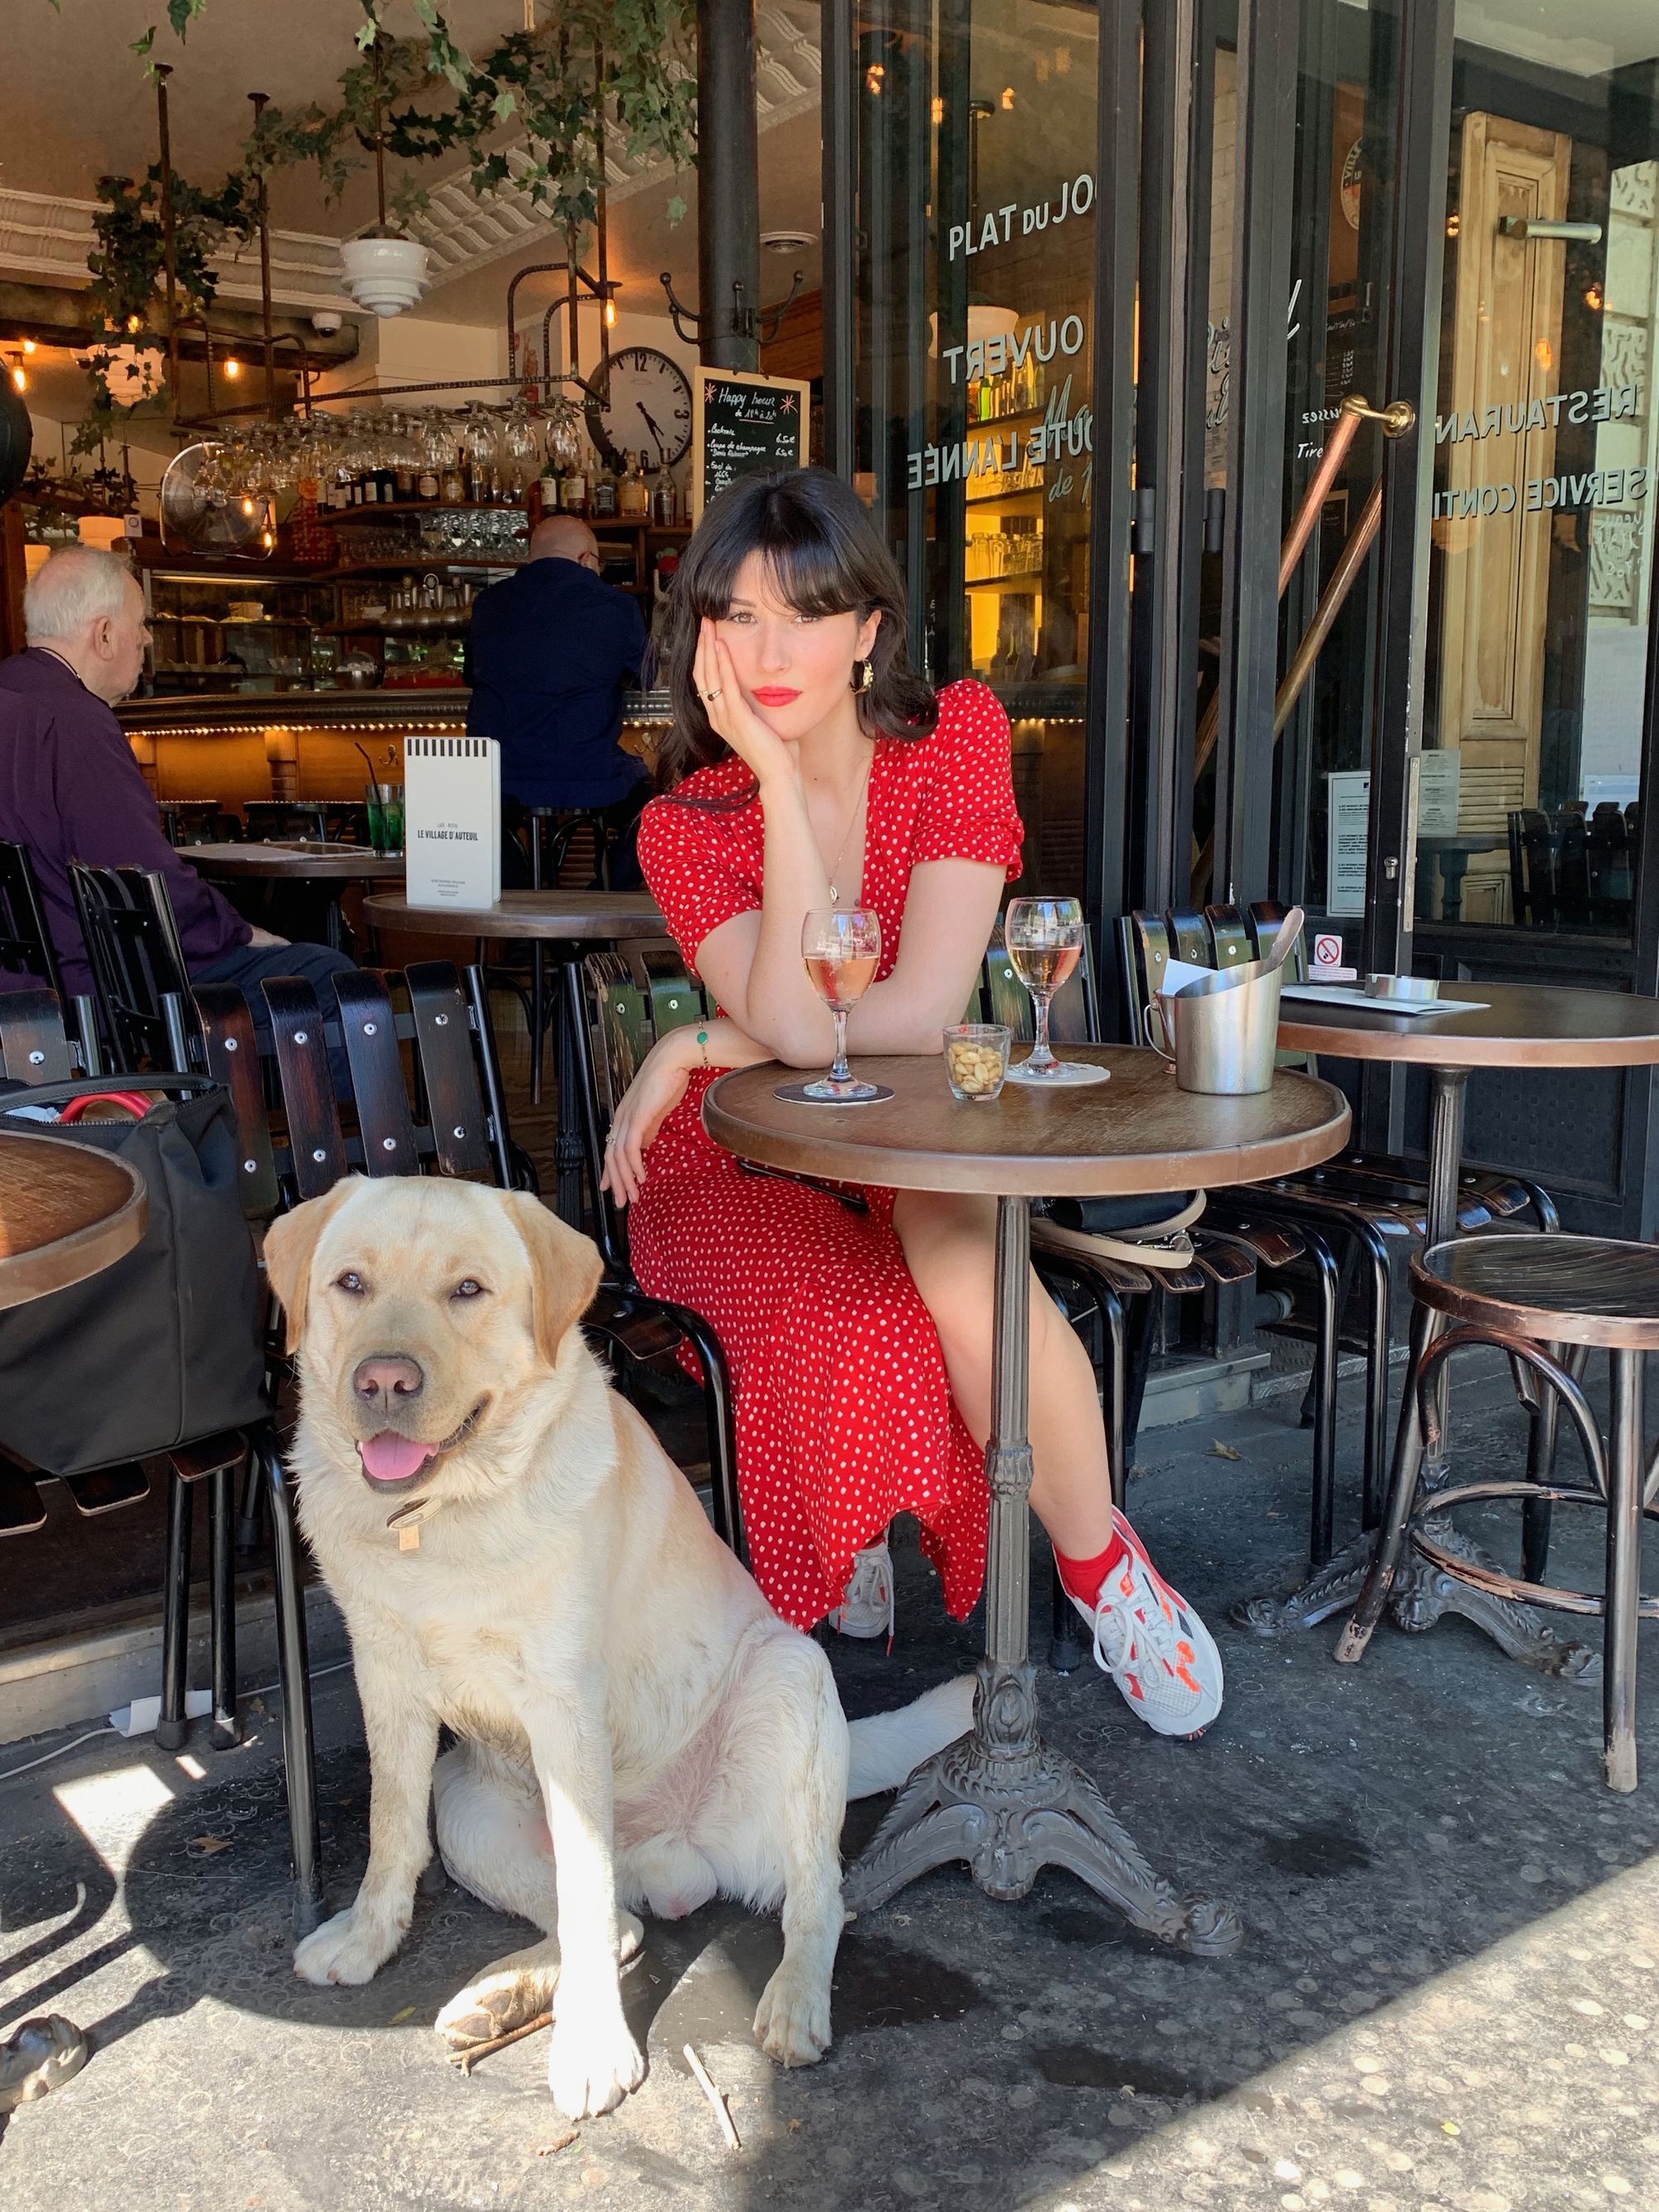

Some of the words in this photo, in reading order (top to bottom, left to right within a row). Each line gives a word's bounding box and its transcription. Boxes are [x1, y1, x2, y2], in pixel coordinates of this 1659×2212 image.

[950, 203, 1018, 261] PLAT
[1022, 202, 1049, 236] DU
[1052, 173, 1097, 225] JO
[718, 387, 747, 409] Happy
[727, 441, 735, 450] de
[736, 441, 766, 456] champagne
[1048, 467, 1074, 503] de
[417, 830, 424, 839] LE
[425, 830, 449, 840] VILLAGE
